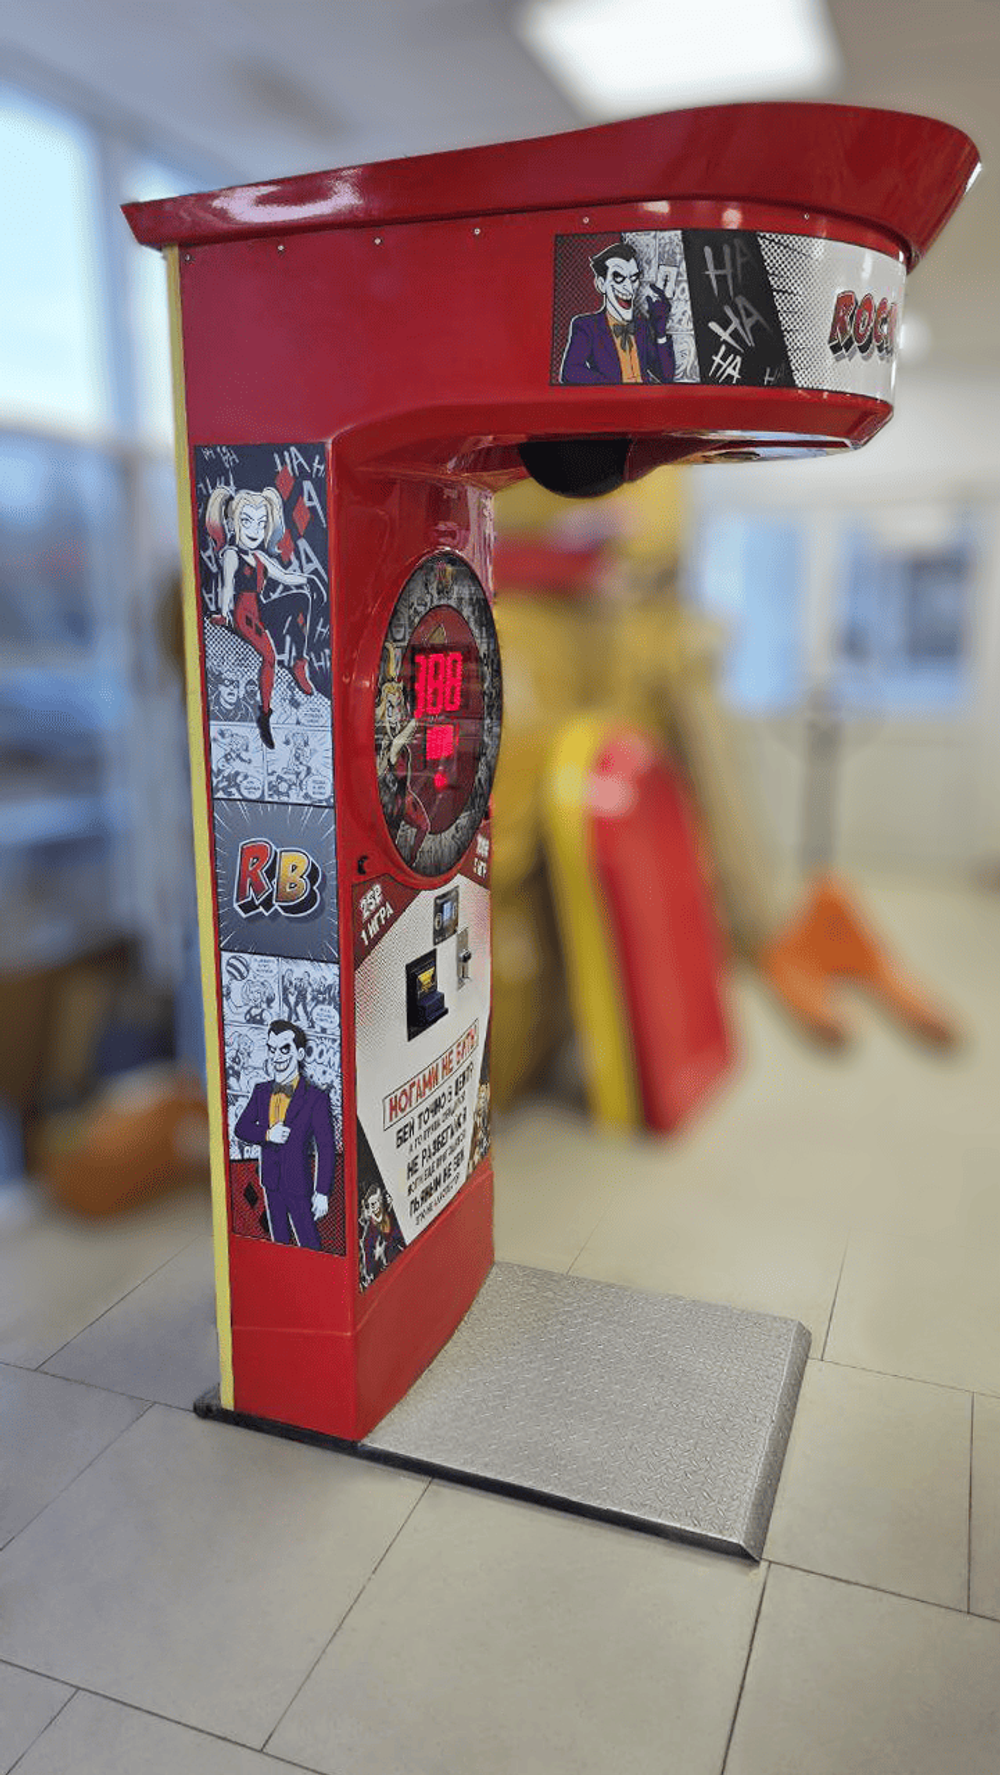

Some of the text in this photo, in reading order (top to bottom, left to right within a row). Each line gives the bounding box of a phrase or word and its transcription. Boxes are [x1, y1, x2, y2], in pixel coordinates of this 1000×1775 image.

[708, 295, 773, 353] HA
[708, 343, 742, 384] HA
[233, 838, 322, 918] RB
[361, 901, 394, 946] 1 ИГРА
[389, 1062, 440, 1123] НОГАМИ
[441, 1048, 454, 1080] НЕ
[396, 1116, 415, 1150] БЕЙ
[407, 1154, 419, 1181] НЕ
